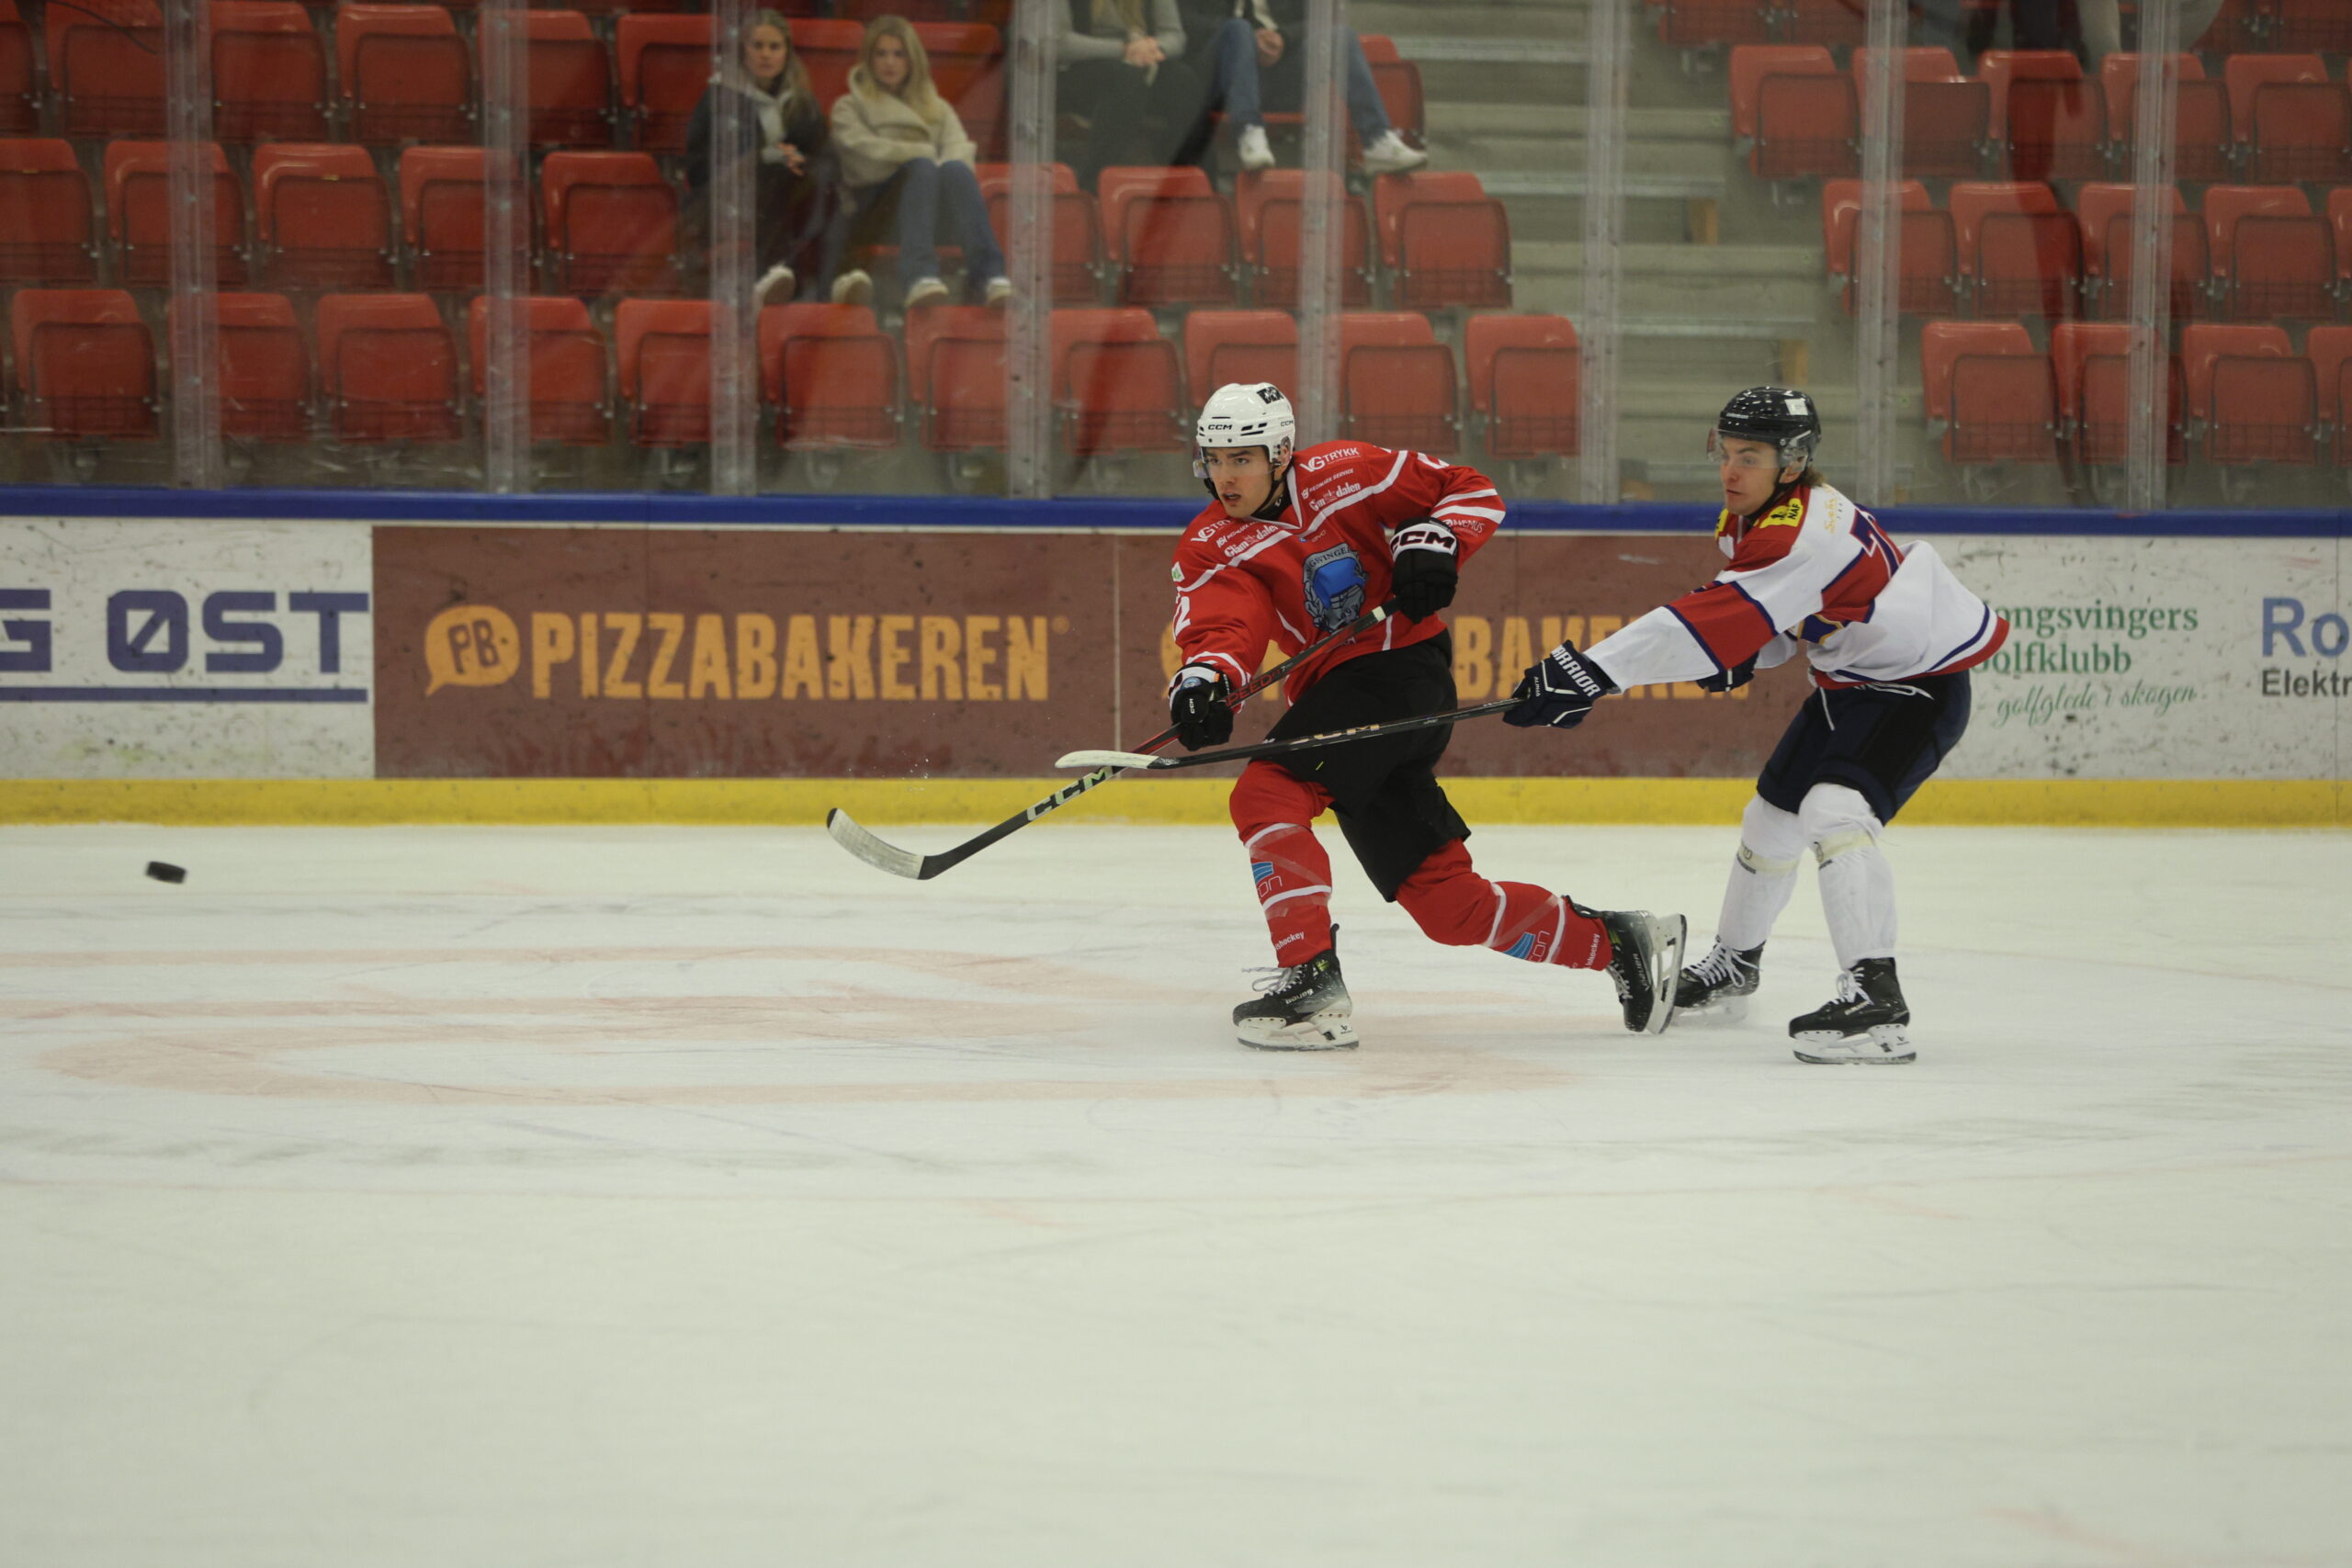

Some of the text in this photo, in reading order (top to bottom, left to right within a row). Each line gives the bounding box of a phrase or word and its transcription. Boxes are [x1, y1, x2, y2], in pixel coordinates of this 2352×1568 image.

[1323, 447, 1359, 463] TRYKK
[1788, 502, 1800, 520] NAF
[1390, 530, 1455, 552] CCM
[107, 590, 369, 673] ØST
[1988, 600, 2199, 640] ongsvingers
[2262, 597, 2350, 659] Ro
[447, 612, 1049, 701] PB PIZZABAKEREN
[1551, 644, 1600, 697] ARRIOR
[1992, 681, 2098, 728] golfglede
[2120, 679, 2198, 717] skogen
[2262, 668, 2352, 697] Elektr
[1027, 765, 1114, 821] CCM
